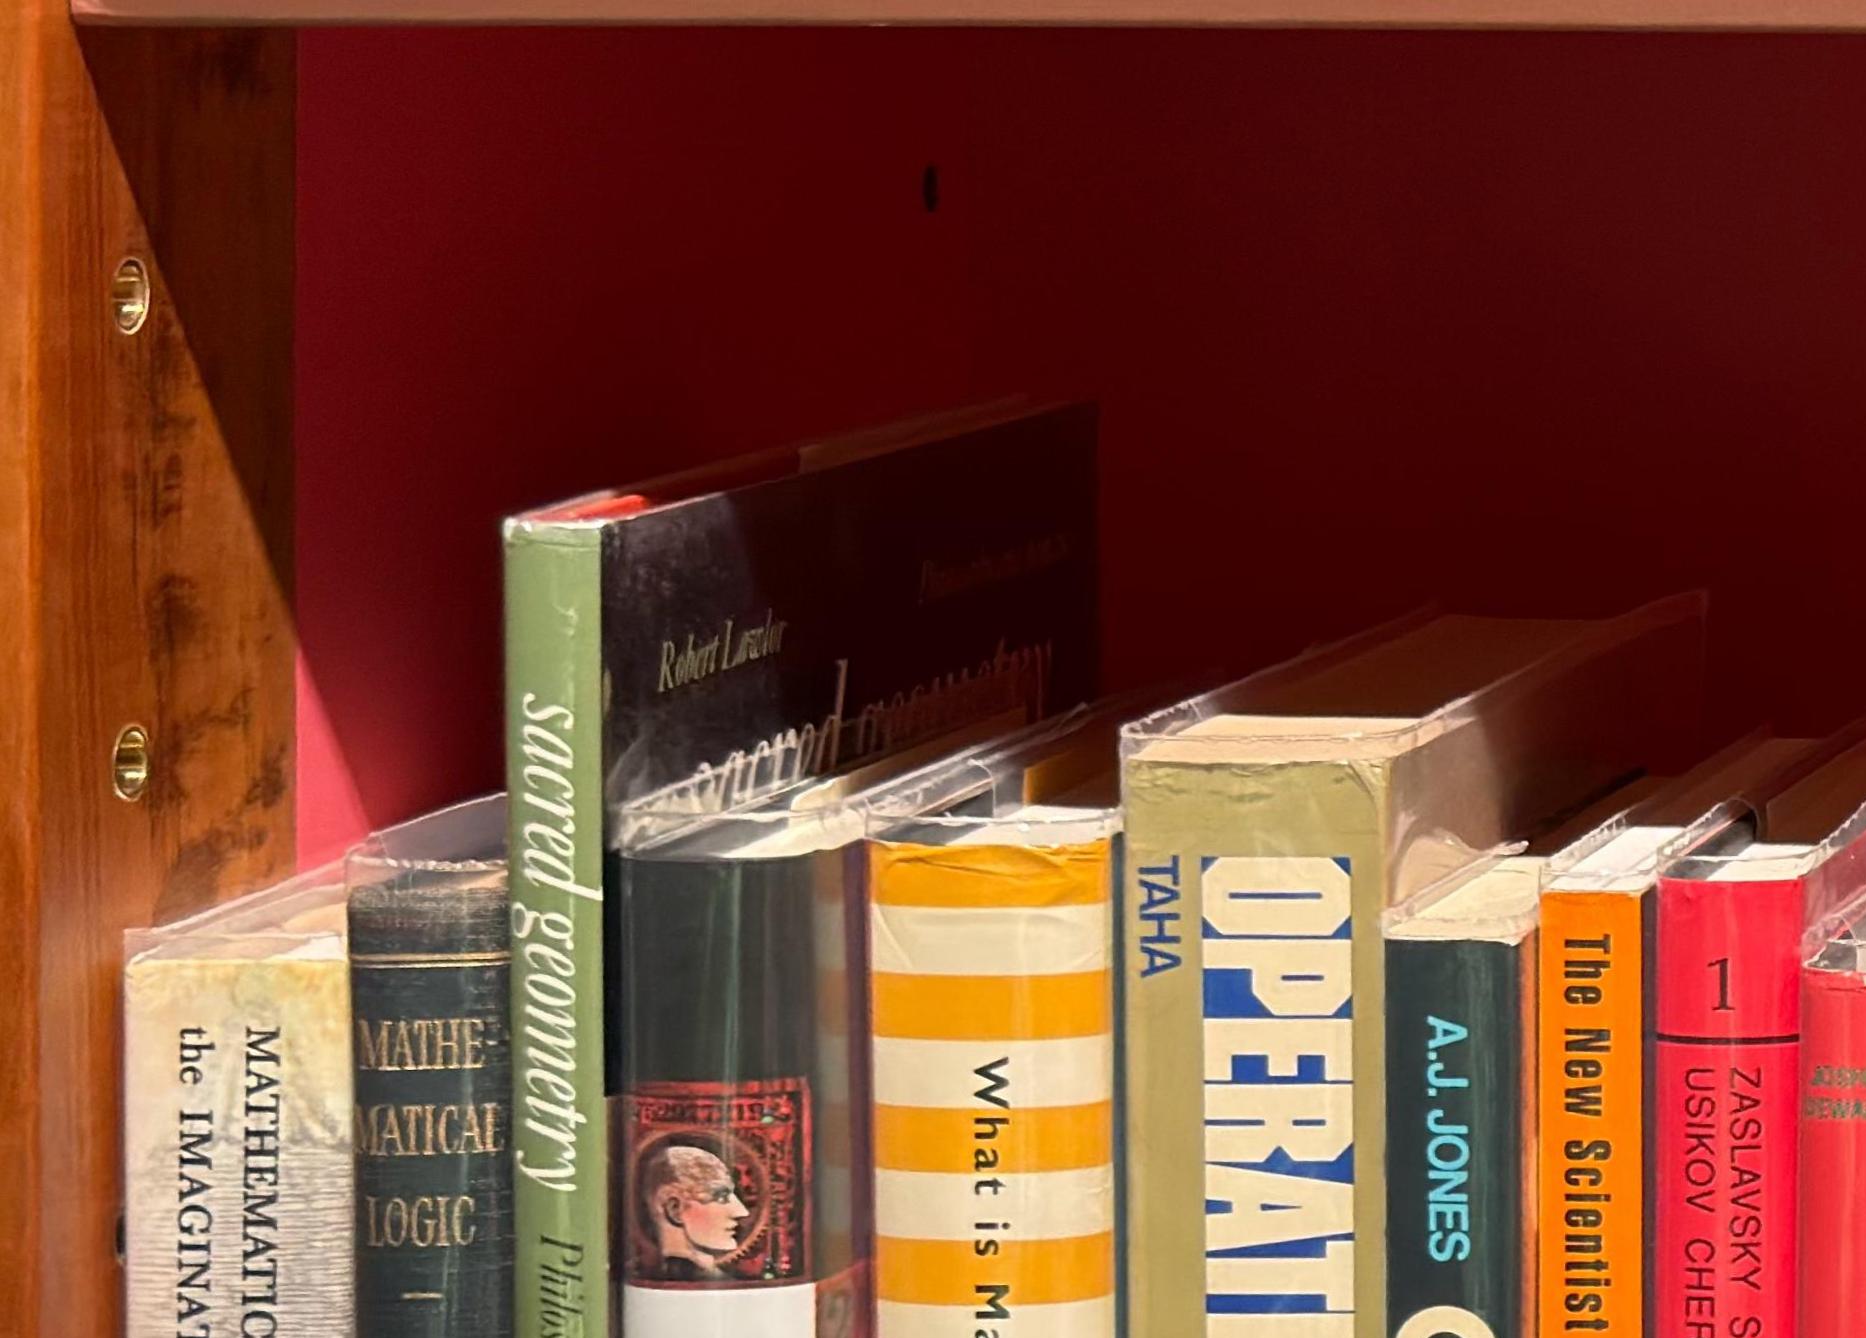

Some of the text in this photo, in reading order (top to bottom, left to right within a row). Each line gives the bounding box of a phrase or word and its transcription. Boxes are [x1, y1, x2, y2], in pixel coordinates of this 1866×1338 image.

[512, 693, 603, 1193] sacred geometry
[1138, 855, 1182, 977] TAHA
[1563, 934, 1610, 1006] The
[177, 1027, 215, 1084] the
[1563, 1028, 1610, 1117] New
[354, 1102, 504, 1156] MATICAL
[972, 1056, 1012, 1195] What
[1426, 1014, 1469, 1262] A.J. JONES
[1685, 1068, 1716, 1213] USIKOV
[1730, 1066, 1762, 1290] ZASLAVSKY
[364, 1196, 476, 1247] LOGIC
[974, 1220, 1012, 1258] is
[1563, 1140, 1610, 1331] Scientist
